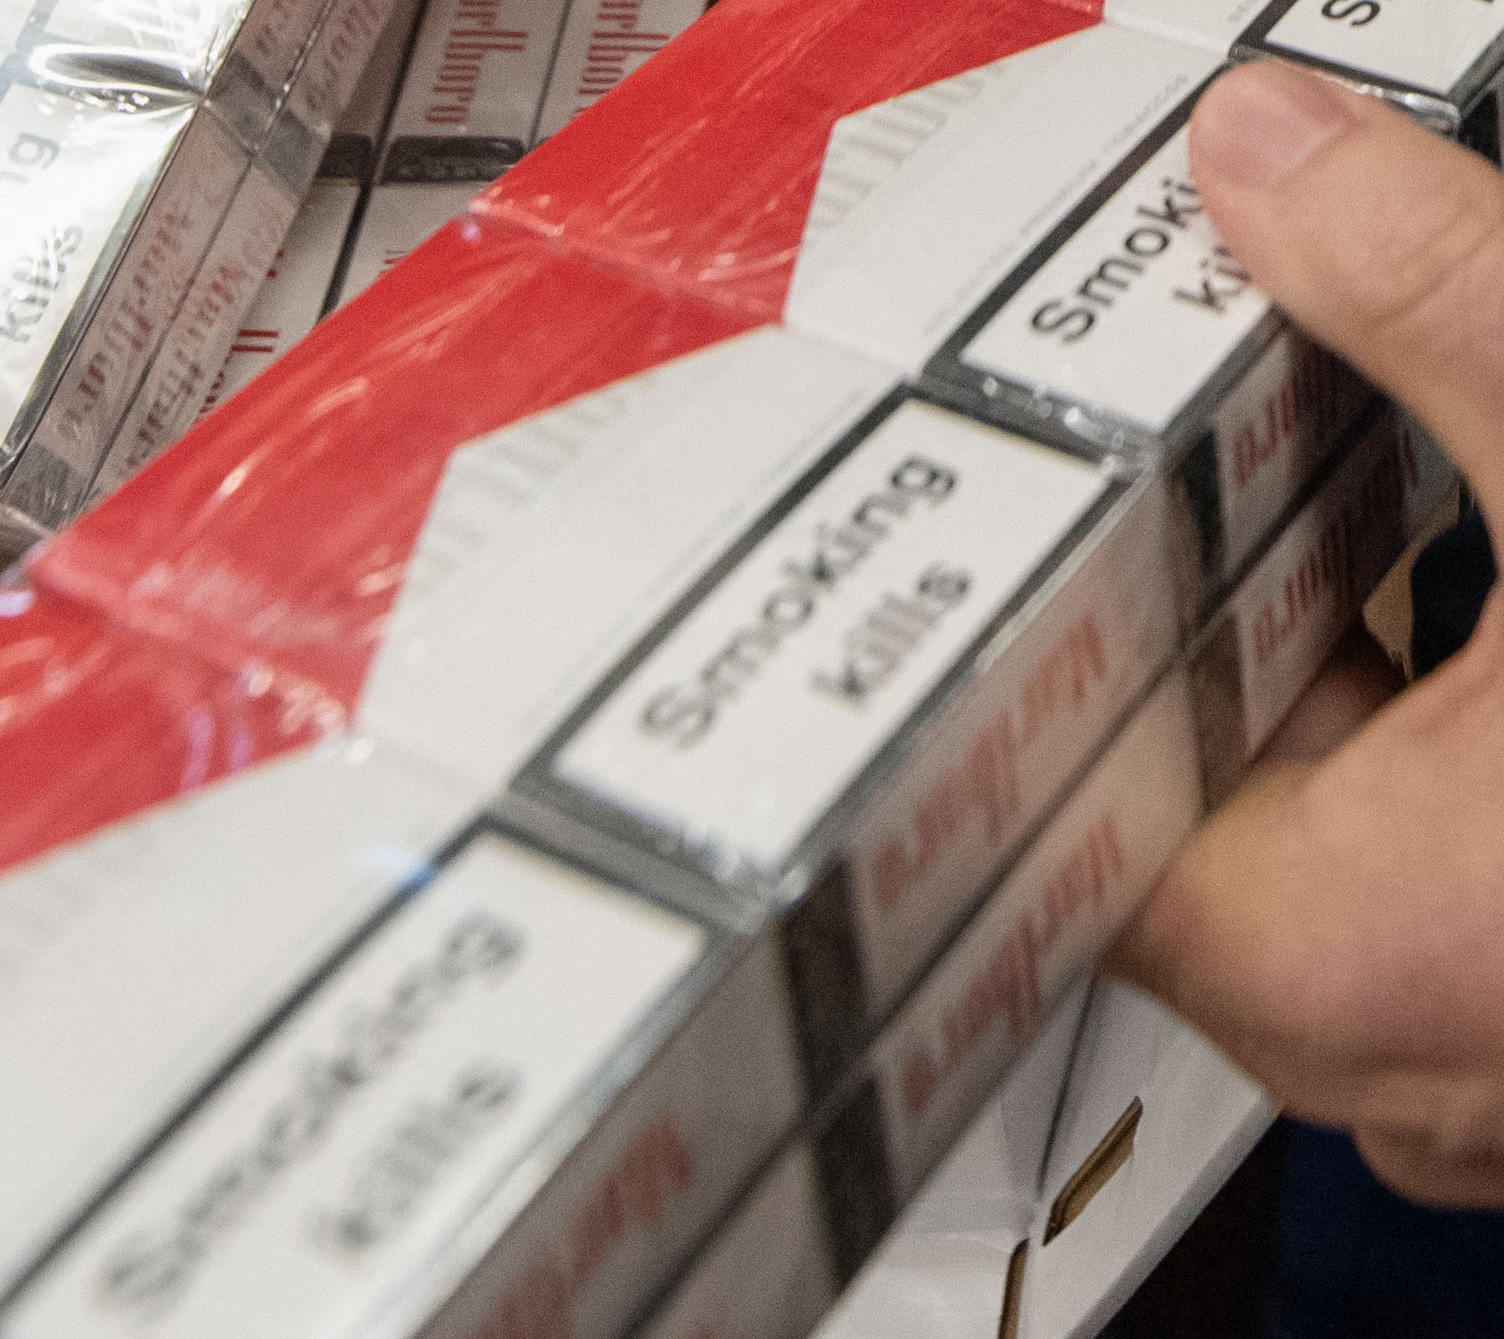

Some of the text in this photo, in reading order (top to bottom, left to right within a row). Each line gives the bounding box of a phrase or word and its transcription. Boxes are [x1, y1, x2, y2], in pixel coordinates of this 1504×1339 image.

[1029, 176, 1202, 345] Smoki
[638, 451, 959, 753] Smoking
[808, 559, 974, 713] kills
[94, 909, 529, 1329] Smoking
